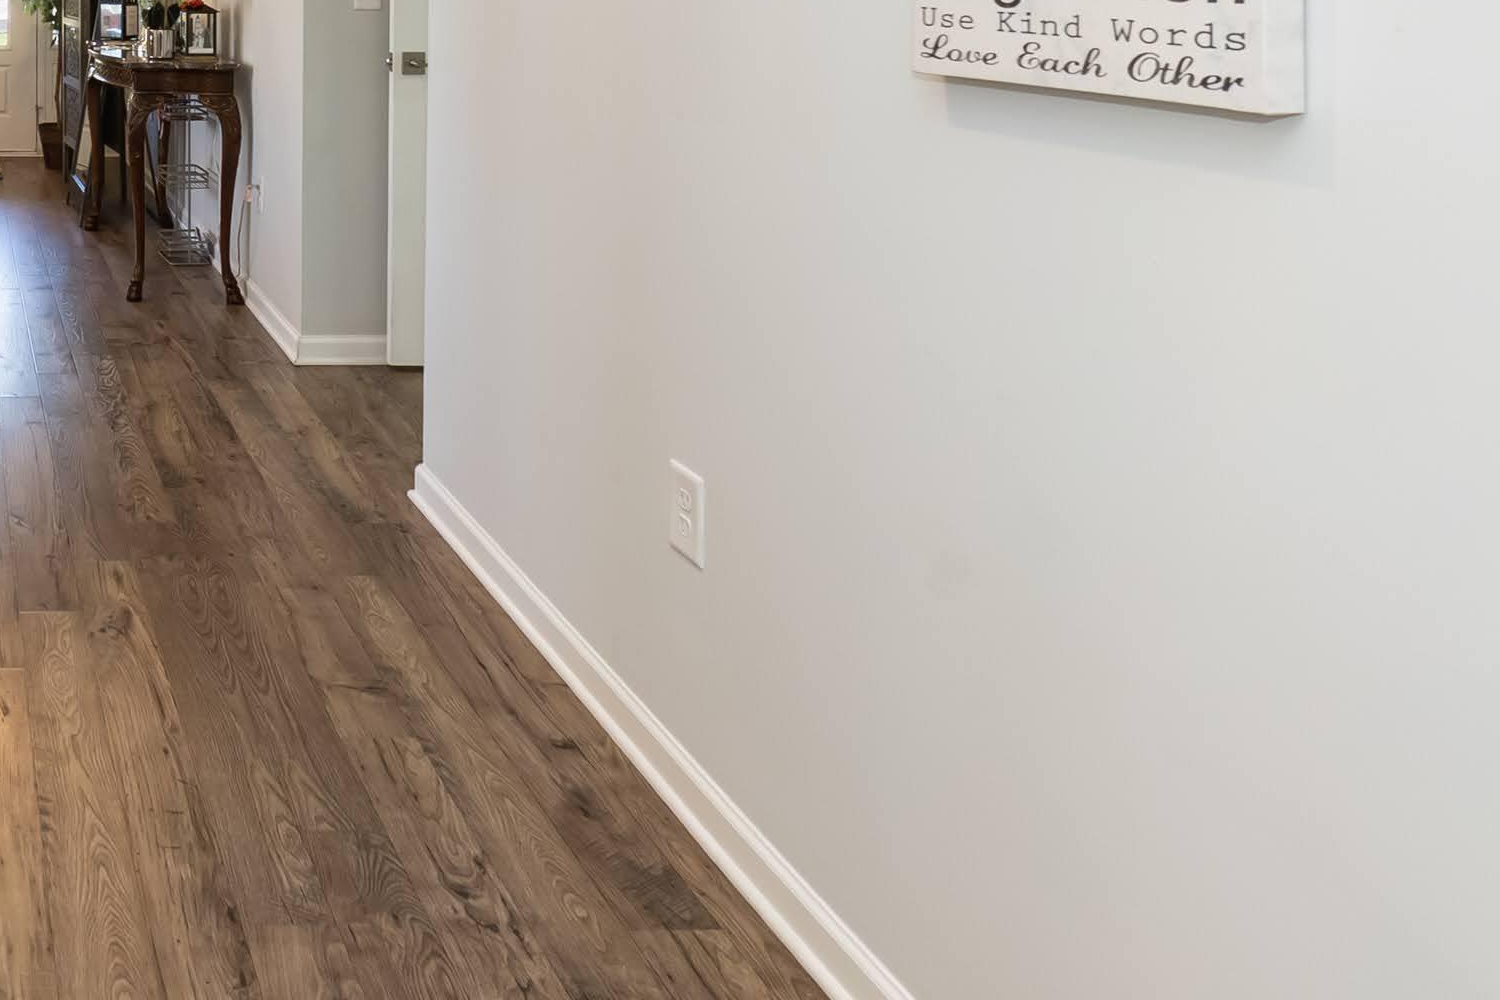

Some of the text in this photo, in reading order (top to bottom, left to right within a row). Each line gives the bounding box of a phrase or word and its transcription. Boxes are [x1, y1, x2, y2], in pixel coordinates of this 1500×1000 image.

[921, 6, 1247, 51] Use Kind Words
[920, 34, 1244, 92] Love Each Other
